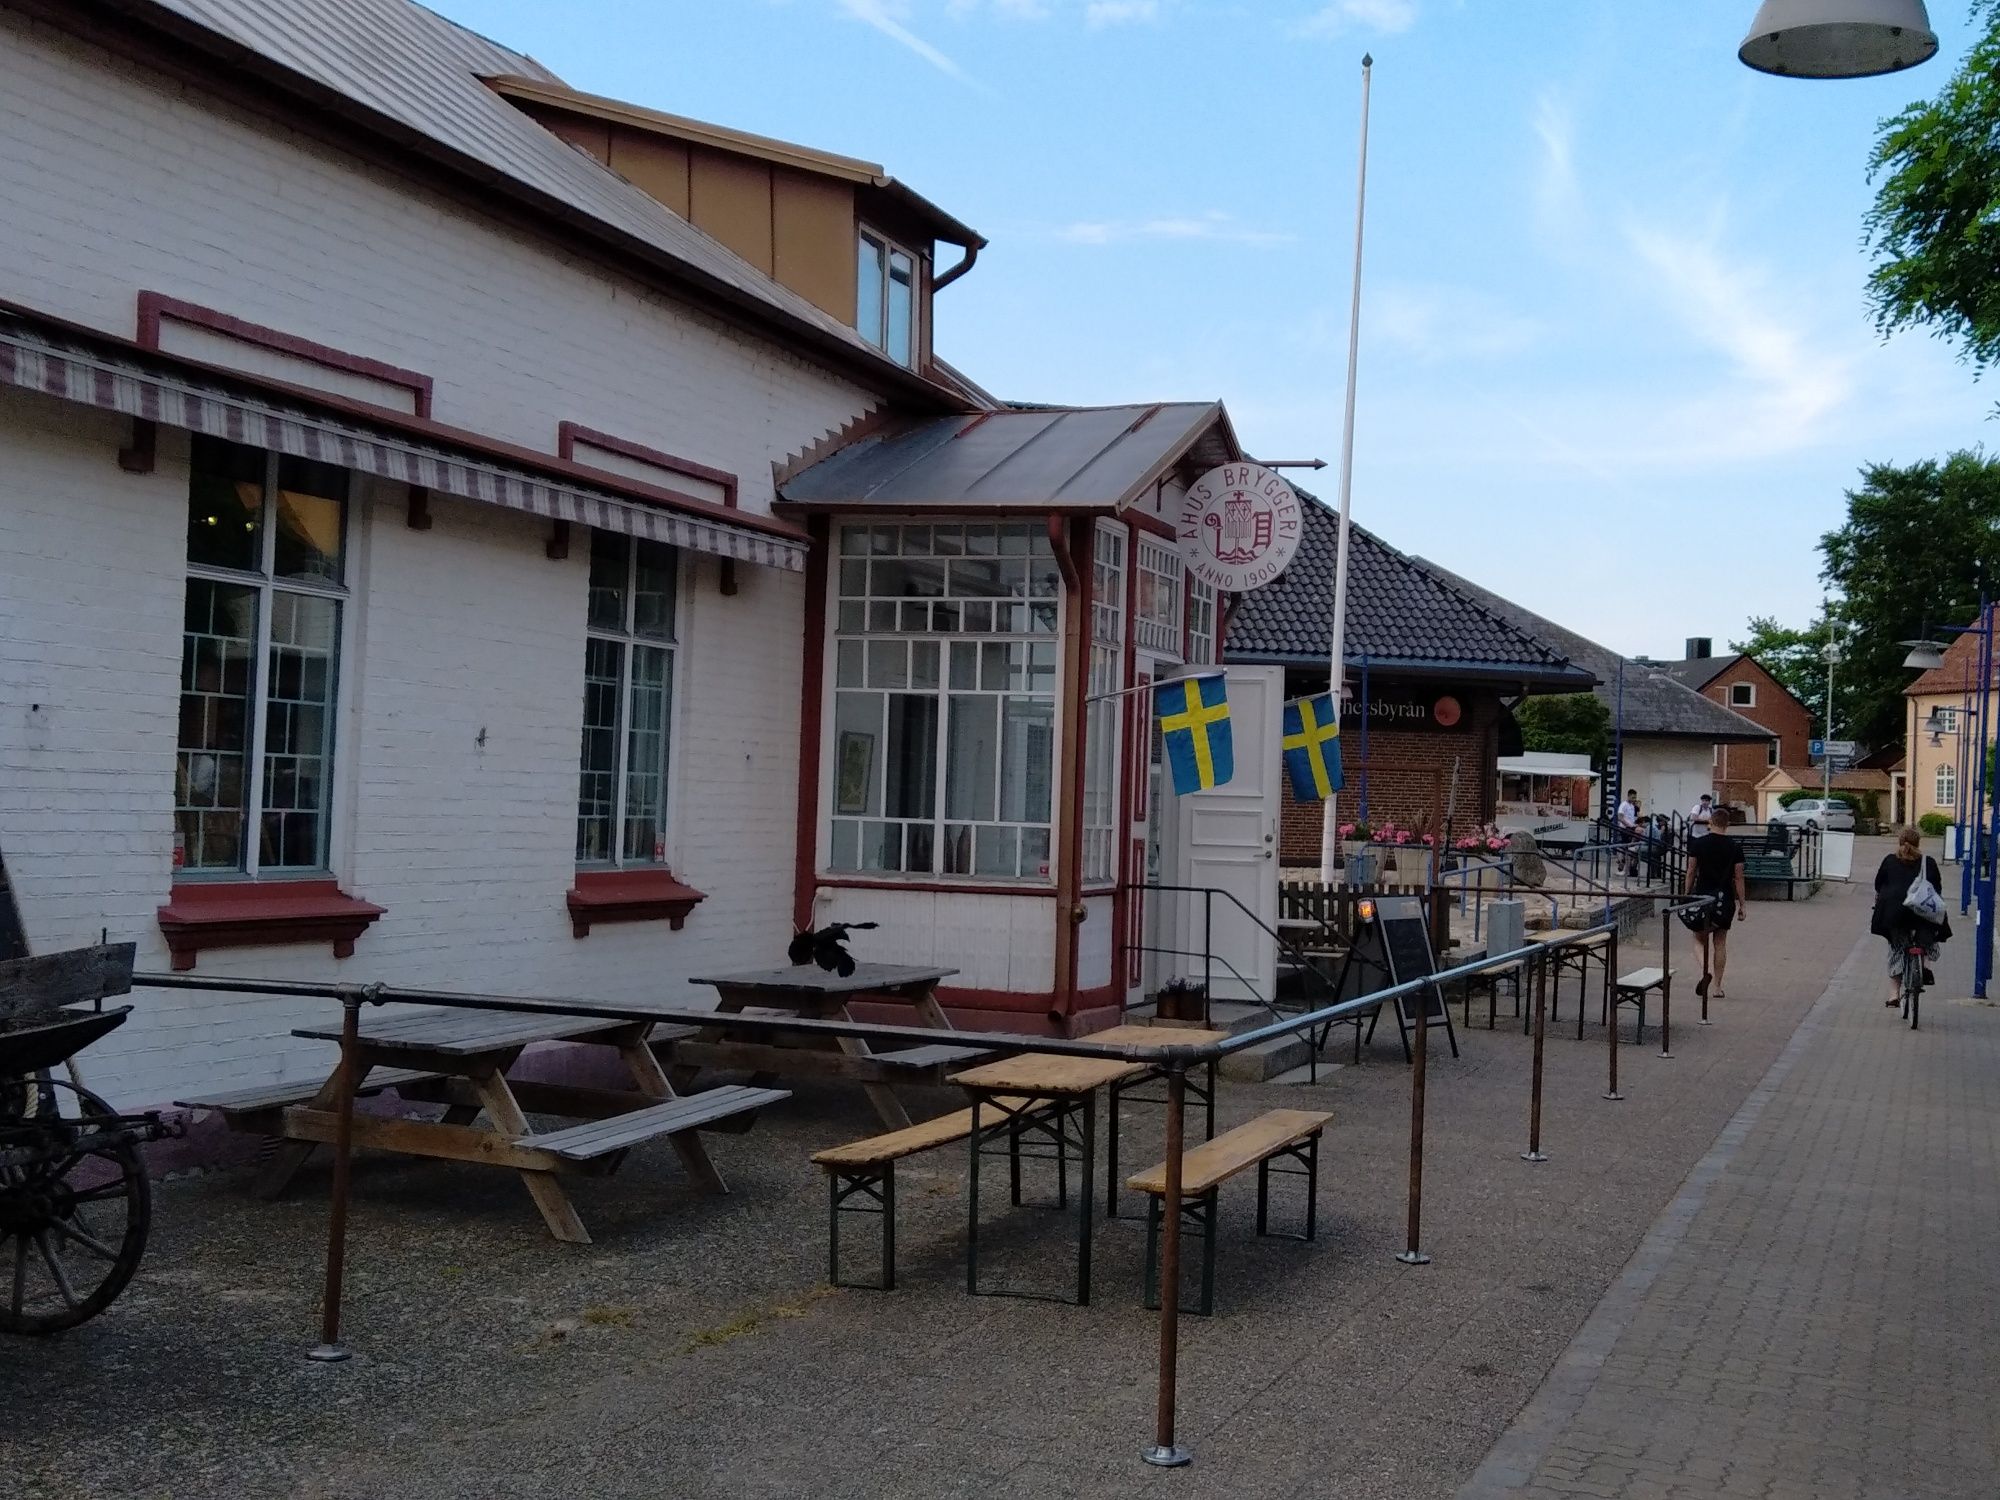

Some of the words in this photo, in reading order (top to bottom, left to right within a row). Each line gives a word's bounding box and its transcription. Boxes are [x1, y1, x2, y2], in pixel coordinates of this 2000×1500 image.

[1223, 466, 1298, 540] BRYGGERI
[1194, 562, 1233, 587] ANNO
[1243, 561, 1277, 587] 1900
